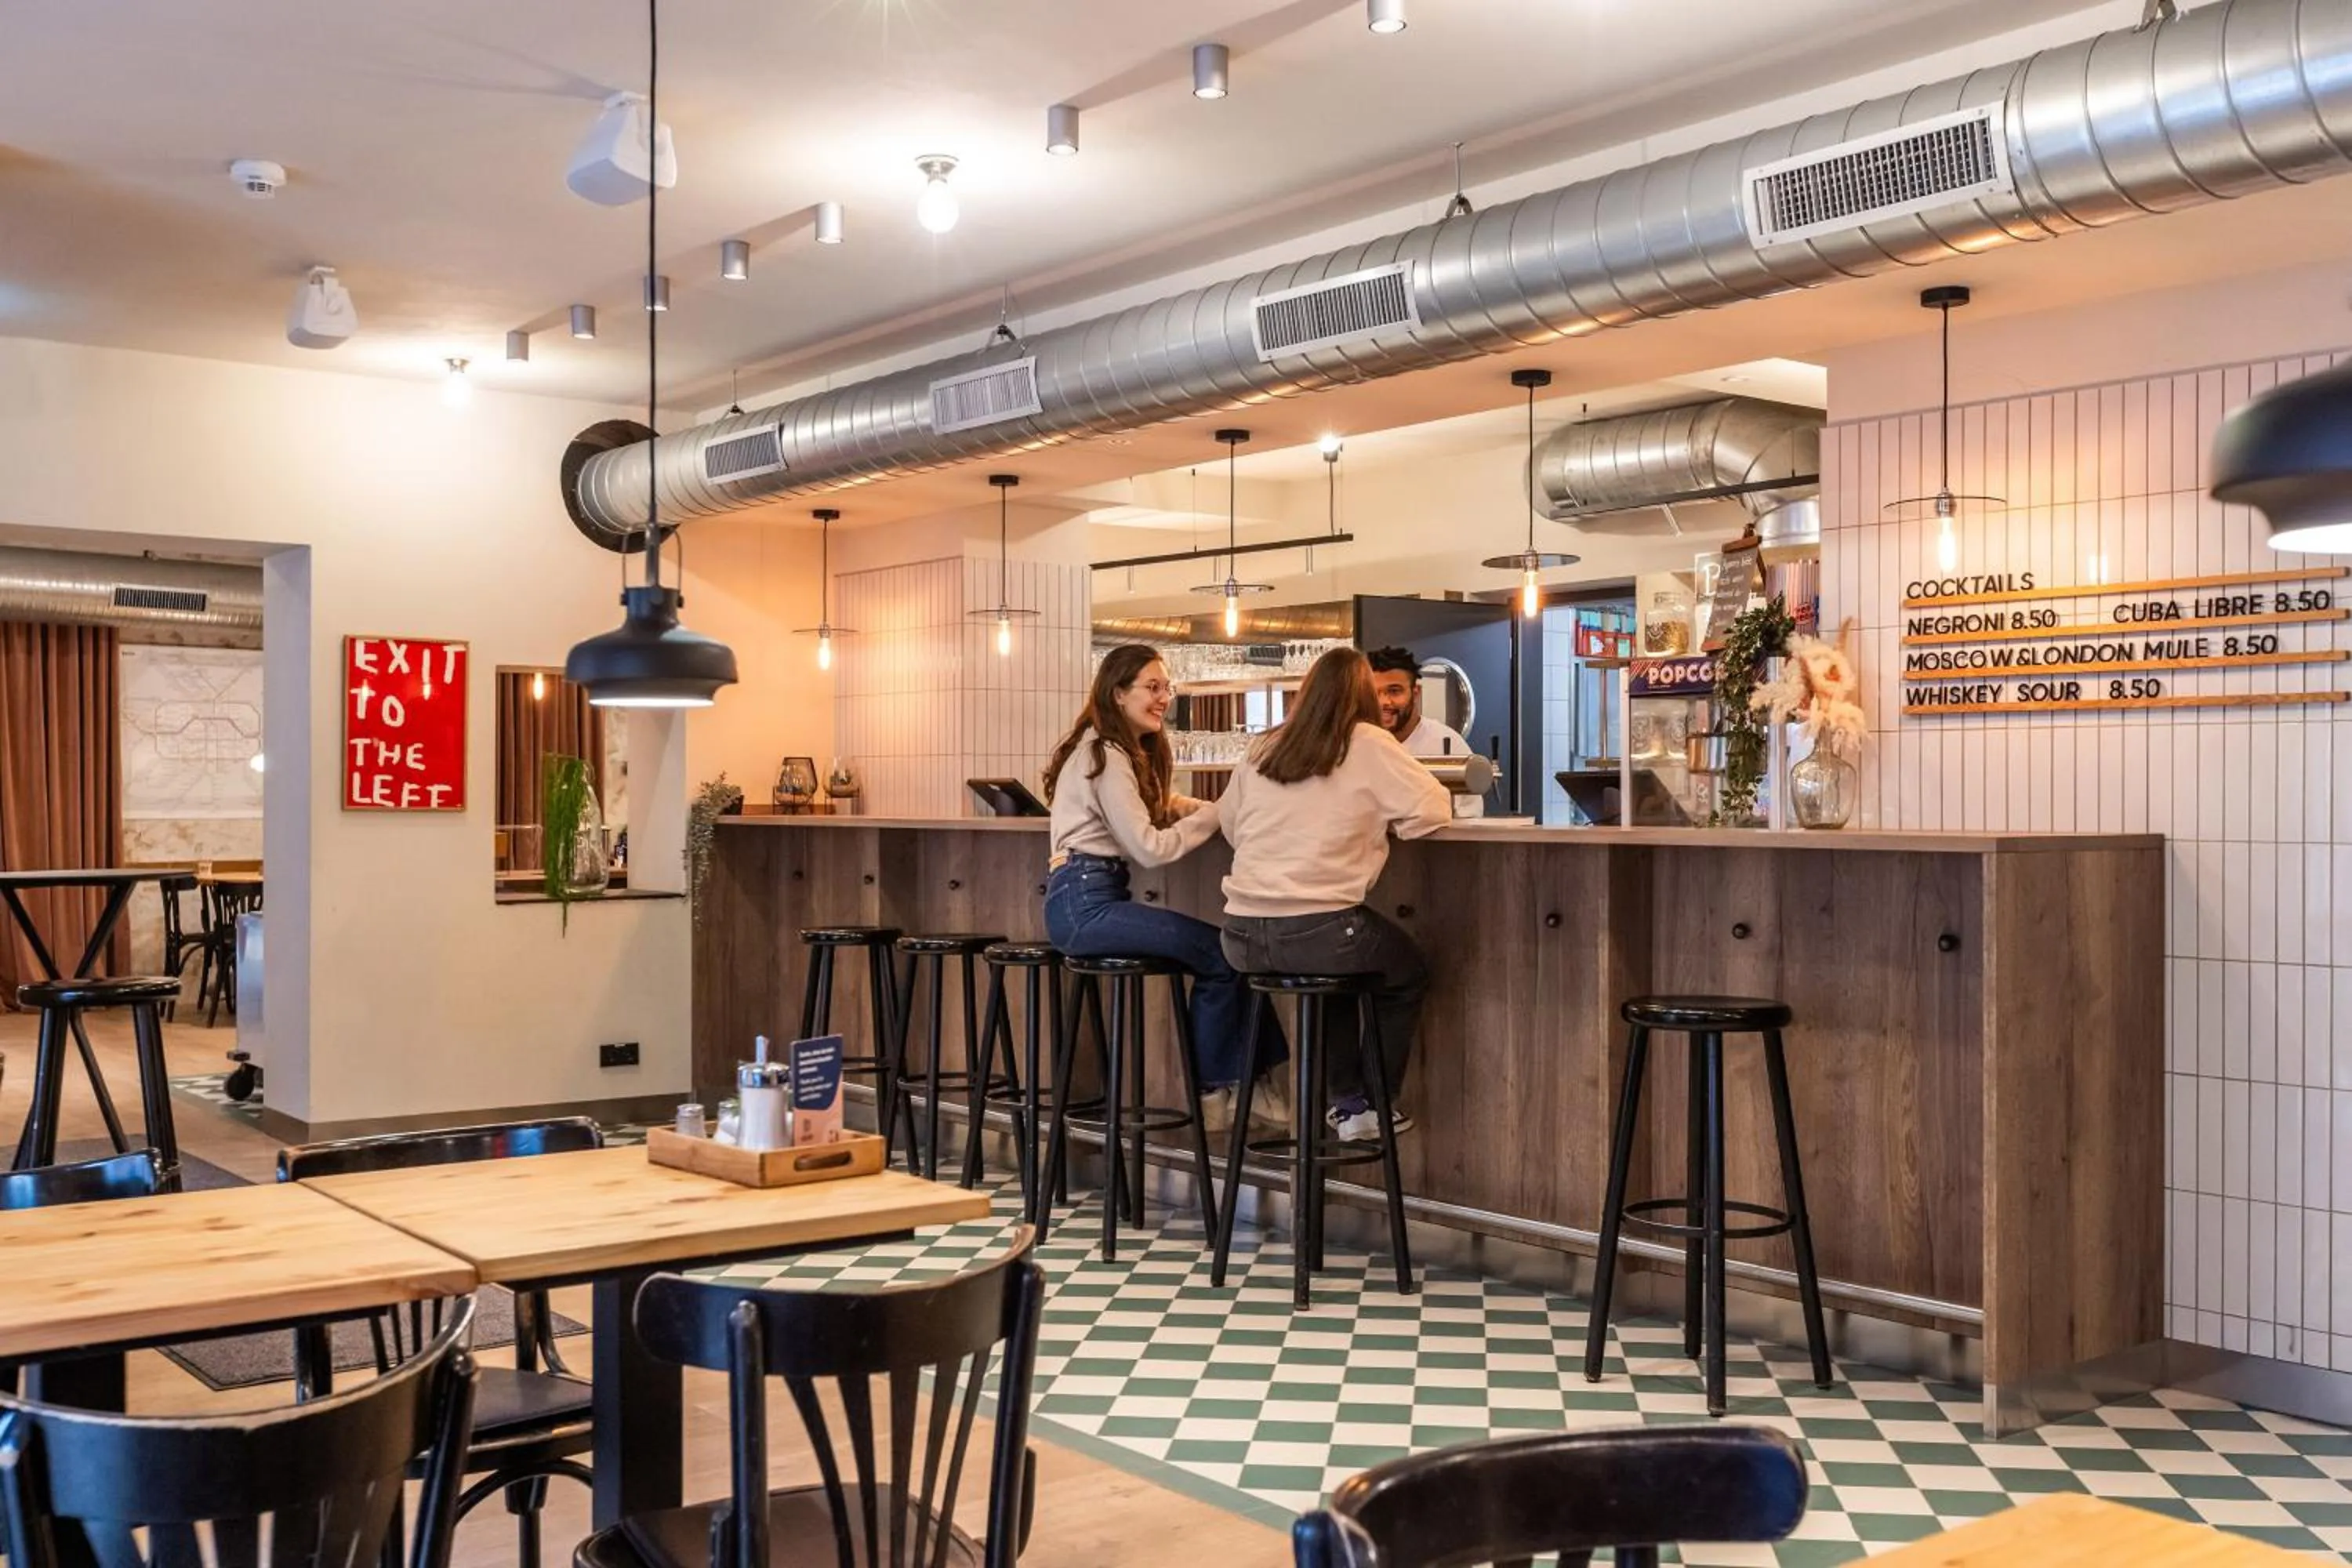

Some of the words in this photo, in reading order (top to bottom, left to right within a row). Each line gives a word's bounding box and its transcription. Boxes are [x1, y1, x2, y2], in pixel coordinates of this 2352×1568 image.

[1906, 572, 2034, 599] COCKTAILS
[2113, 601, 2181, 623] CUBA
[2194, 594, 2264, 618] LIBRE
[2274, 590, 2330, 612] 8.50
[1907, 613, 2004, 636] NEGRONI
[2011, 609, 2056, 629] 8.50
[2143, 638, 2209, 661] MULE
[2223, 634, 2277, 655] 8.50
[354, 640, 466, 691] EXIT
[350, 686, 405, 728] TO
[1906, 684, 2002, 706] WHISKEY
[2017, 681, 2080, 702] SOUR
[2109, 679, 2160, 699] 8.50
[350, 737, 426, 771] THE
